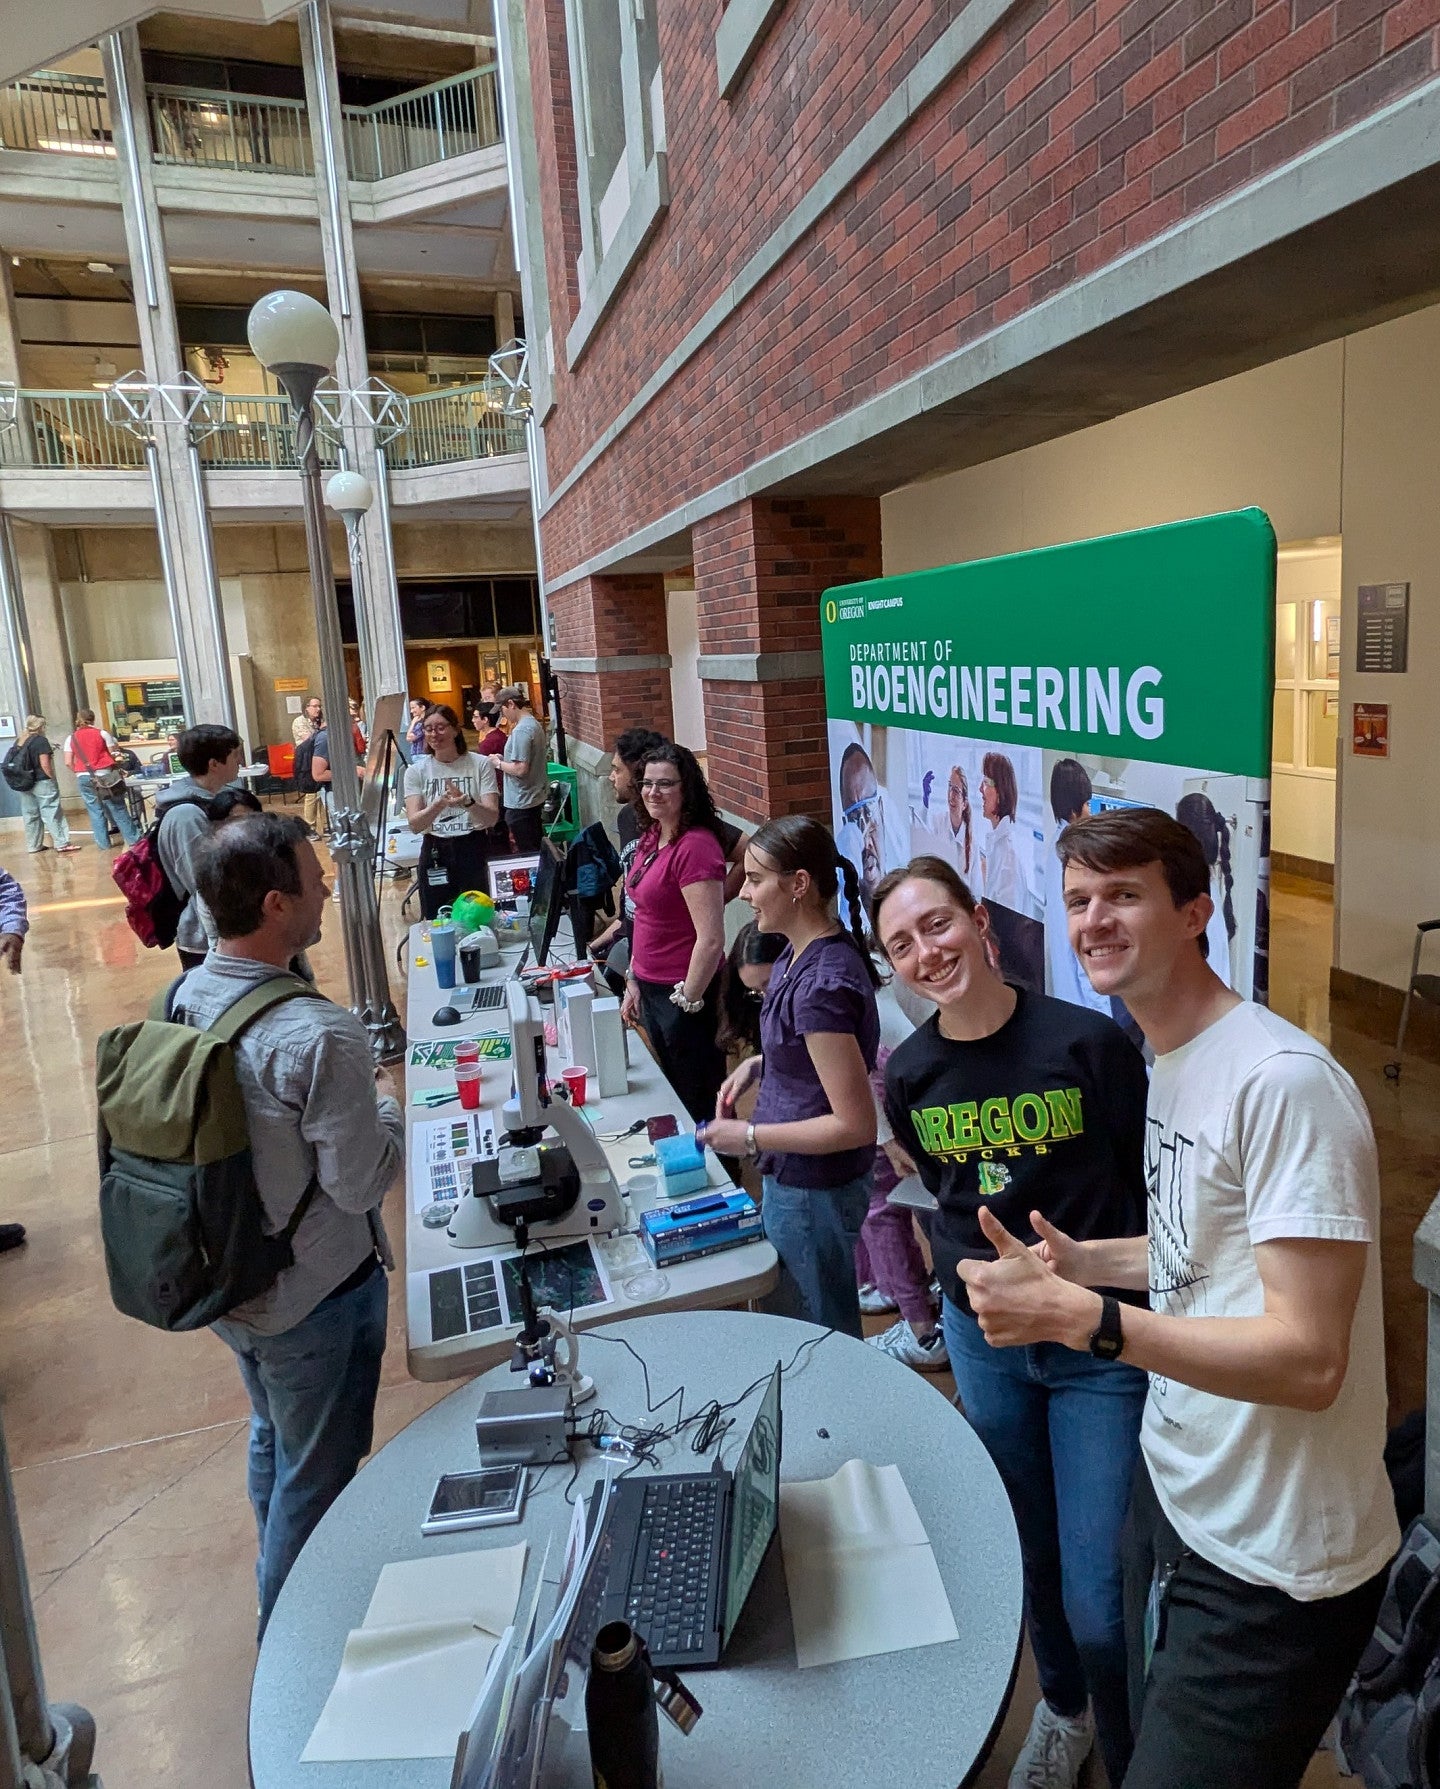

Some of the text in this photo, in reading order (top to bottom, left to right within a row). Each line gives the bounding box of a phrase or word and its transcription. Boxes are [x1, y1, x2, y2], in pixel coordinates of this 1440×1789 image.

[839, 606, 864, 620] OREGON
[867, 597, 903, 610] KNIGHT CAMPUS
[850, 640, 953, 662] DEPARTMENT OF
[851, 664, 1164, 740] BIOENGINEERING
[910, 1087, 1084, 1153] OREGON
